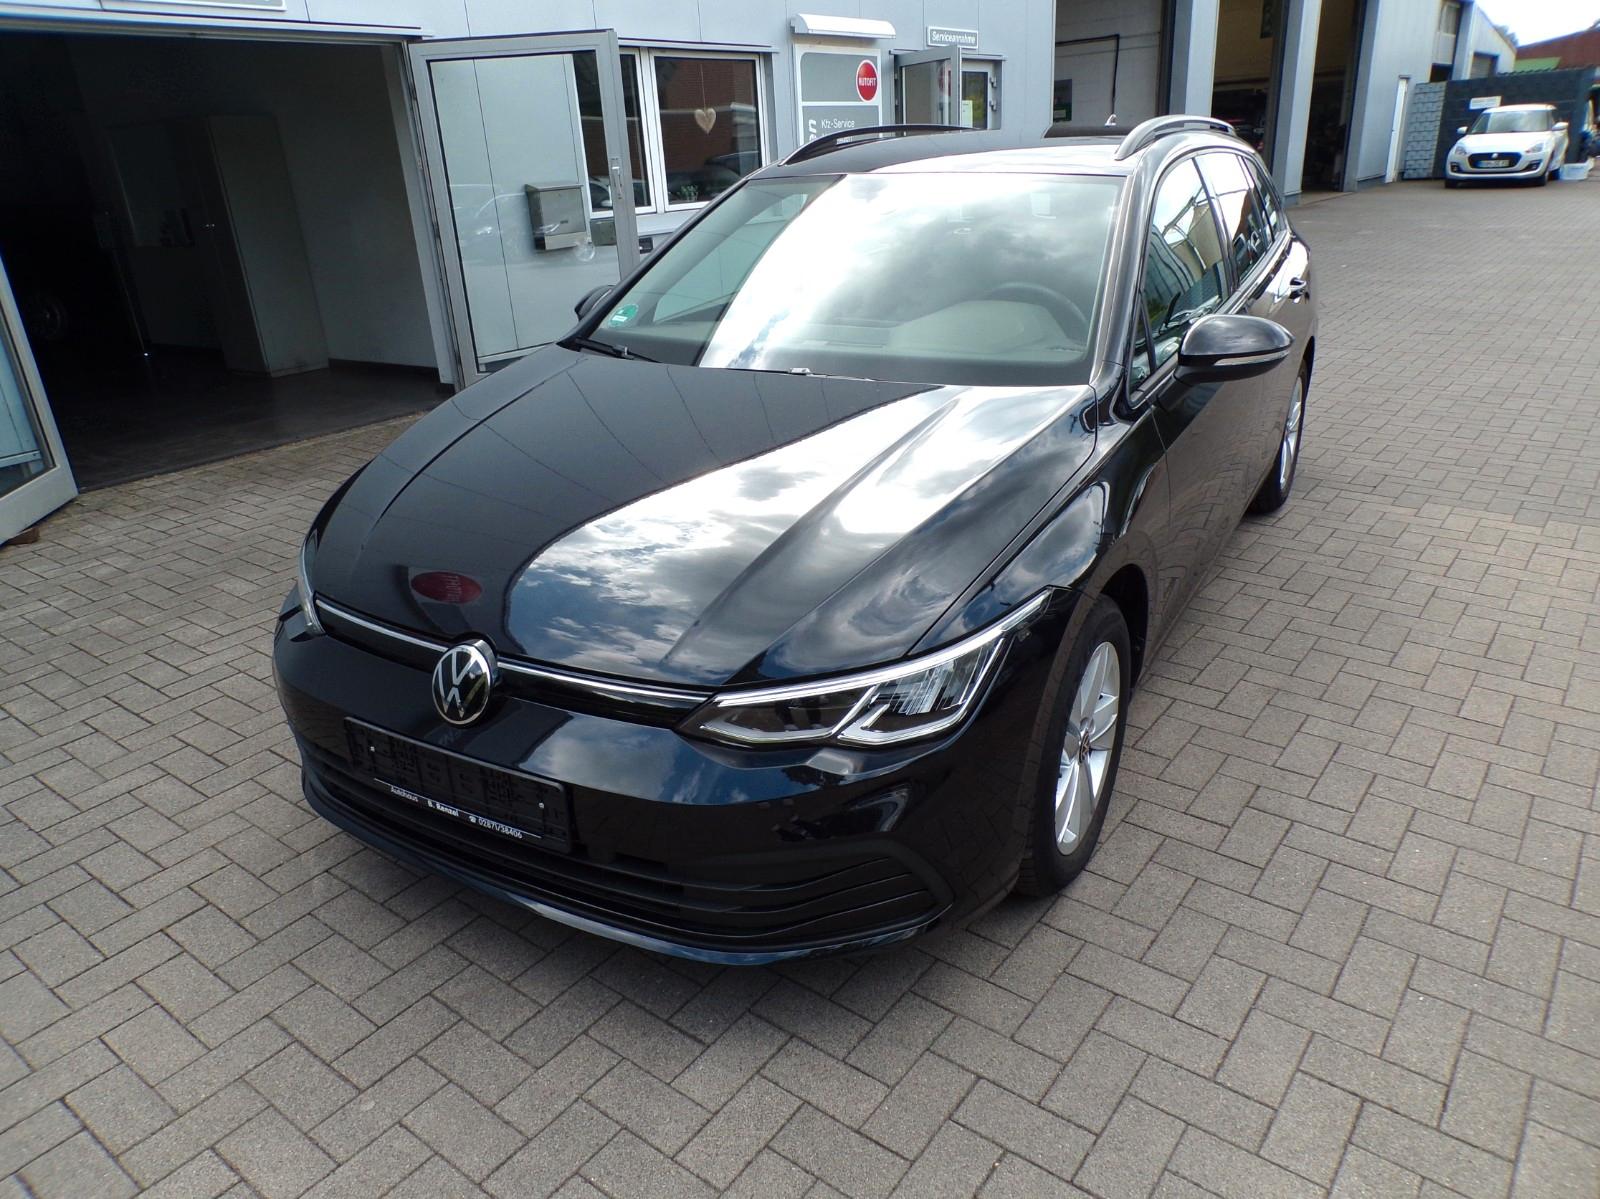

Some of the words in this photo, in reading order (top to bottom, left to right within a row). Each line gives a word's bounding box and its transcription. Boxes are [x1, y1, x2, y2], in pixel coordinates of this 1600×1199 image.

[931, 31, 976, 44] Serviceannahme
[858, 77, 877, 87] AUTOFIT
[821, 118, 856, 129] Kfz-Service
